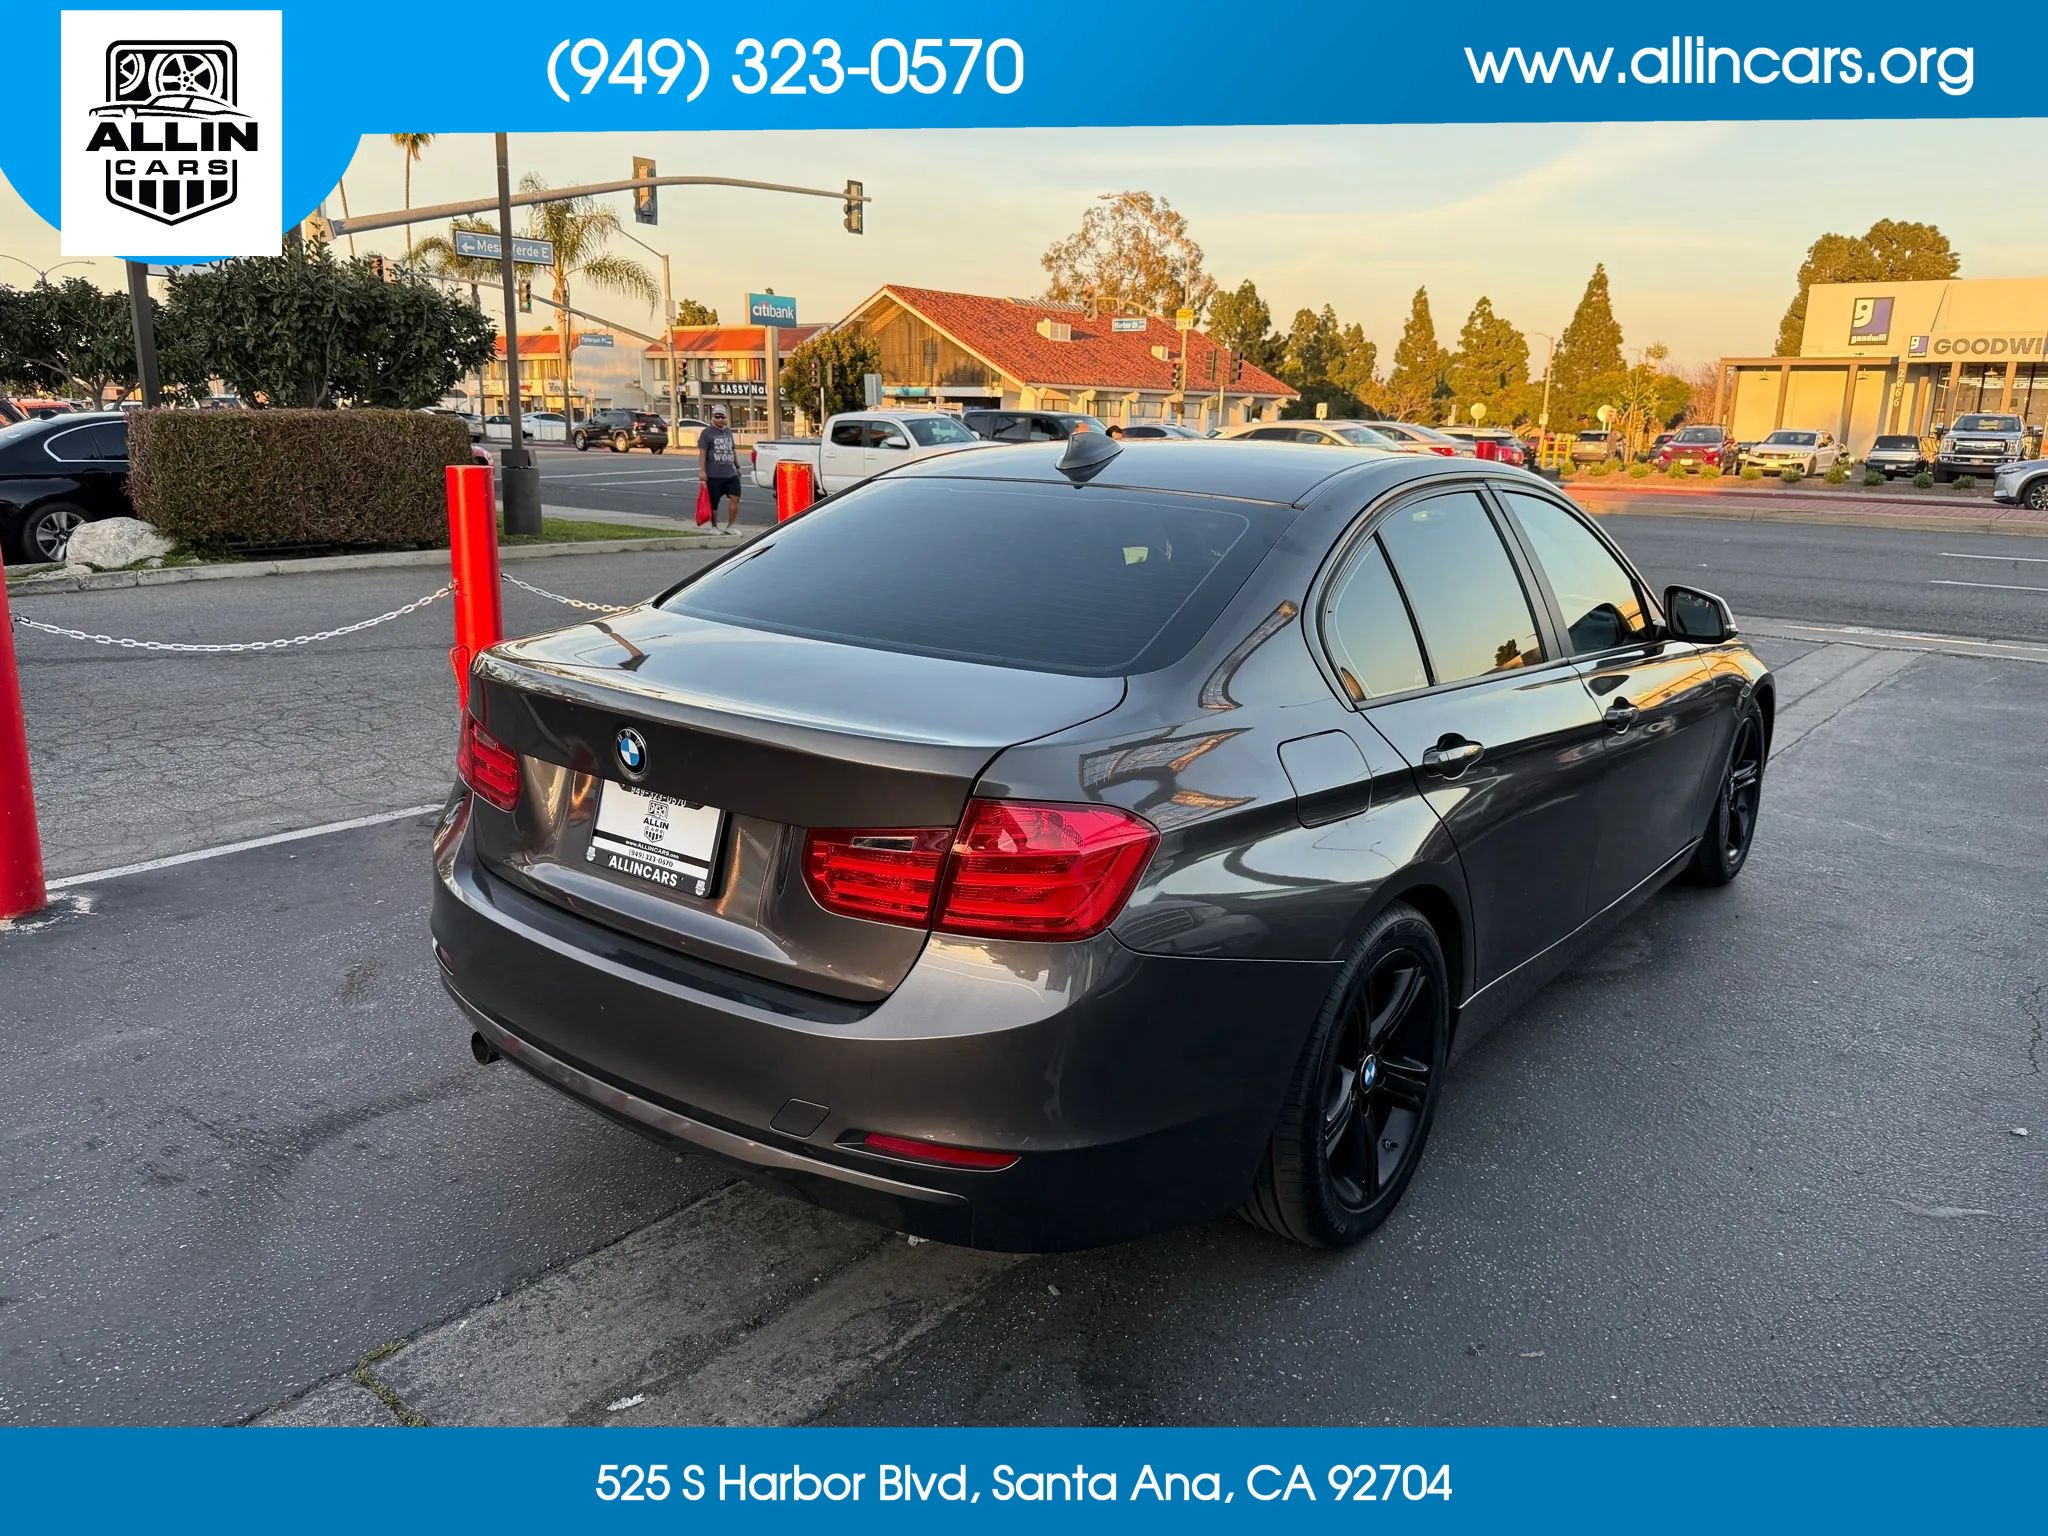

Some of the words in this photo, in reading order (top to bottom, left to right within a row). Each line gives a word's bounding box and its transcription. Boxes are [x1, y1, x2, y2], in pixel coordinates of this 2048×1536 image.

[542, 248, 550, 259] E
[752, 304, 794, 319] citibank
[1851, 333, 1888, 344] goodwill
[720, 384, 749, 394] SASSY
[1892, 369, 1906, 408] 2666
[616, 730, 643, 748] BMW
[643, 817, 670, 831] ALLIN
[628, 848, 645, 860] (949)
[645, 851, 674, 869] 323-0570
[608, 855, 678, 887] ALLINCARS
